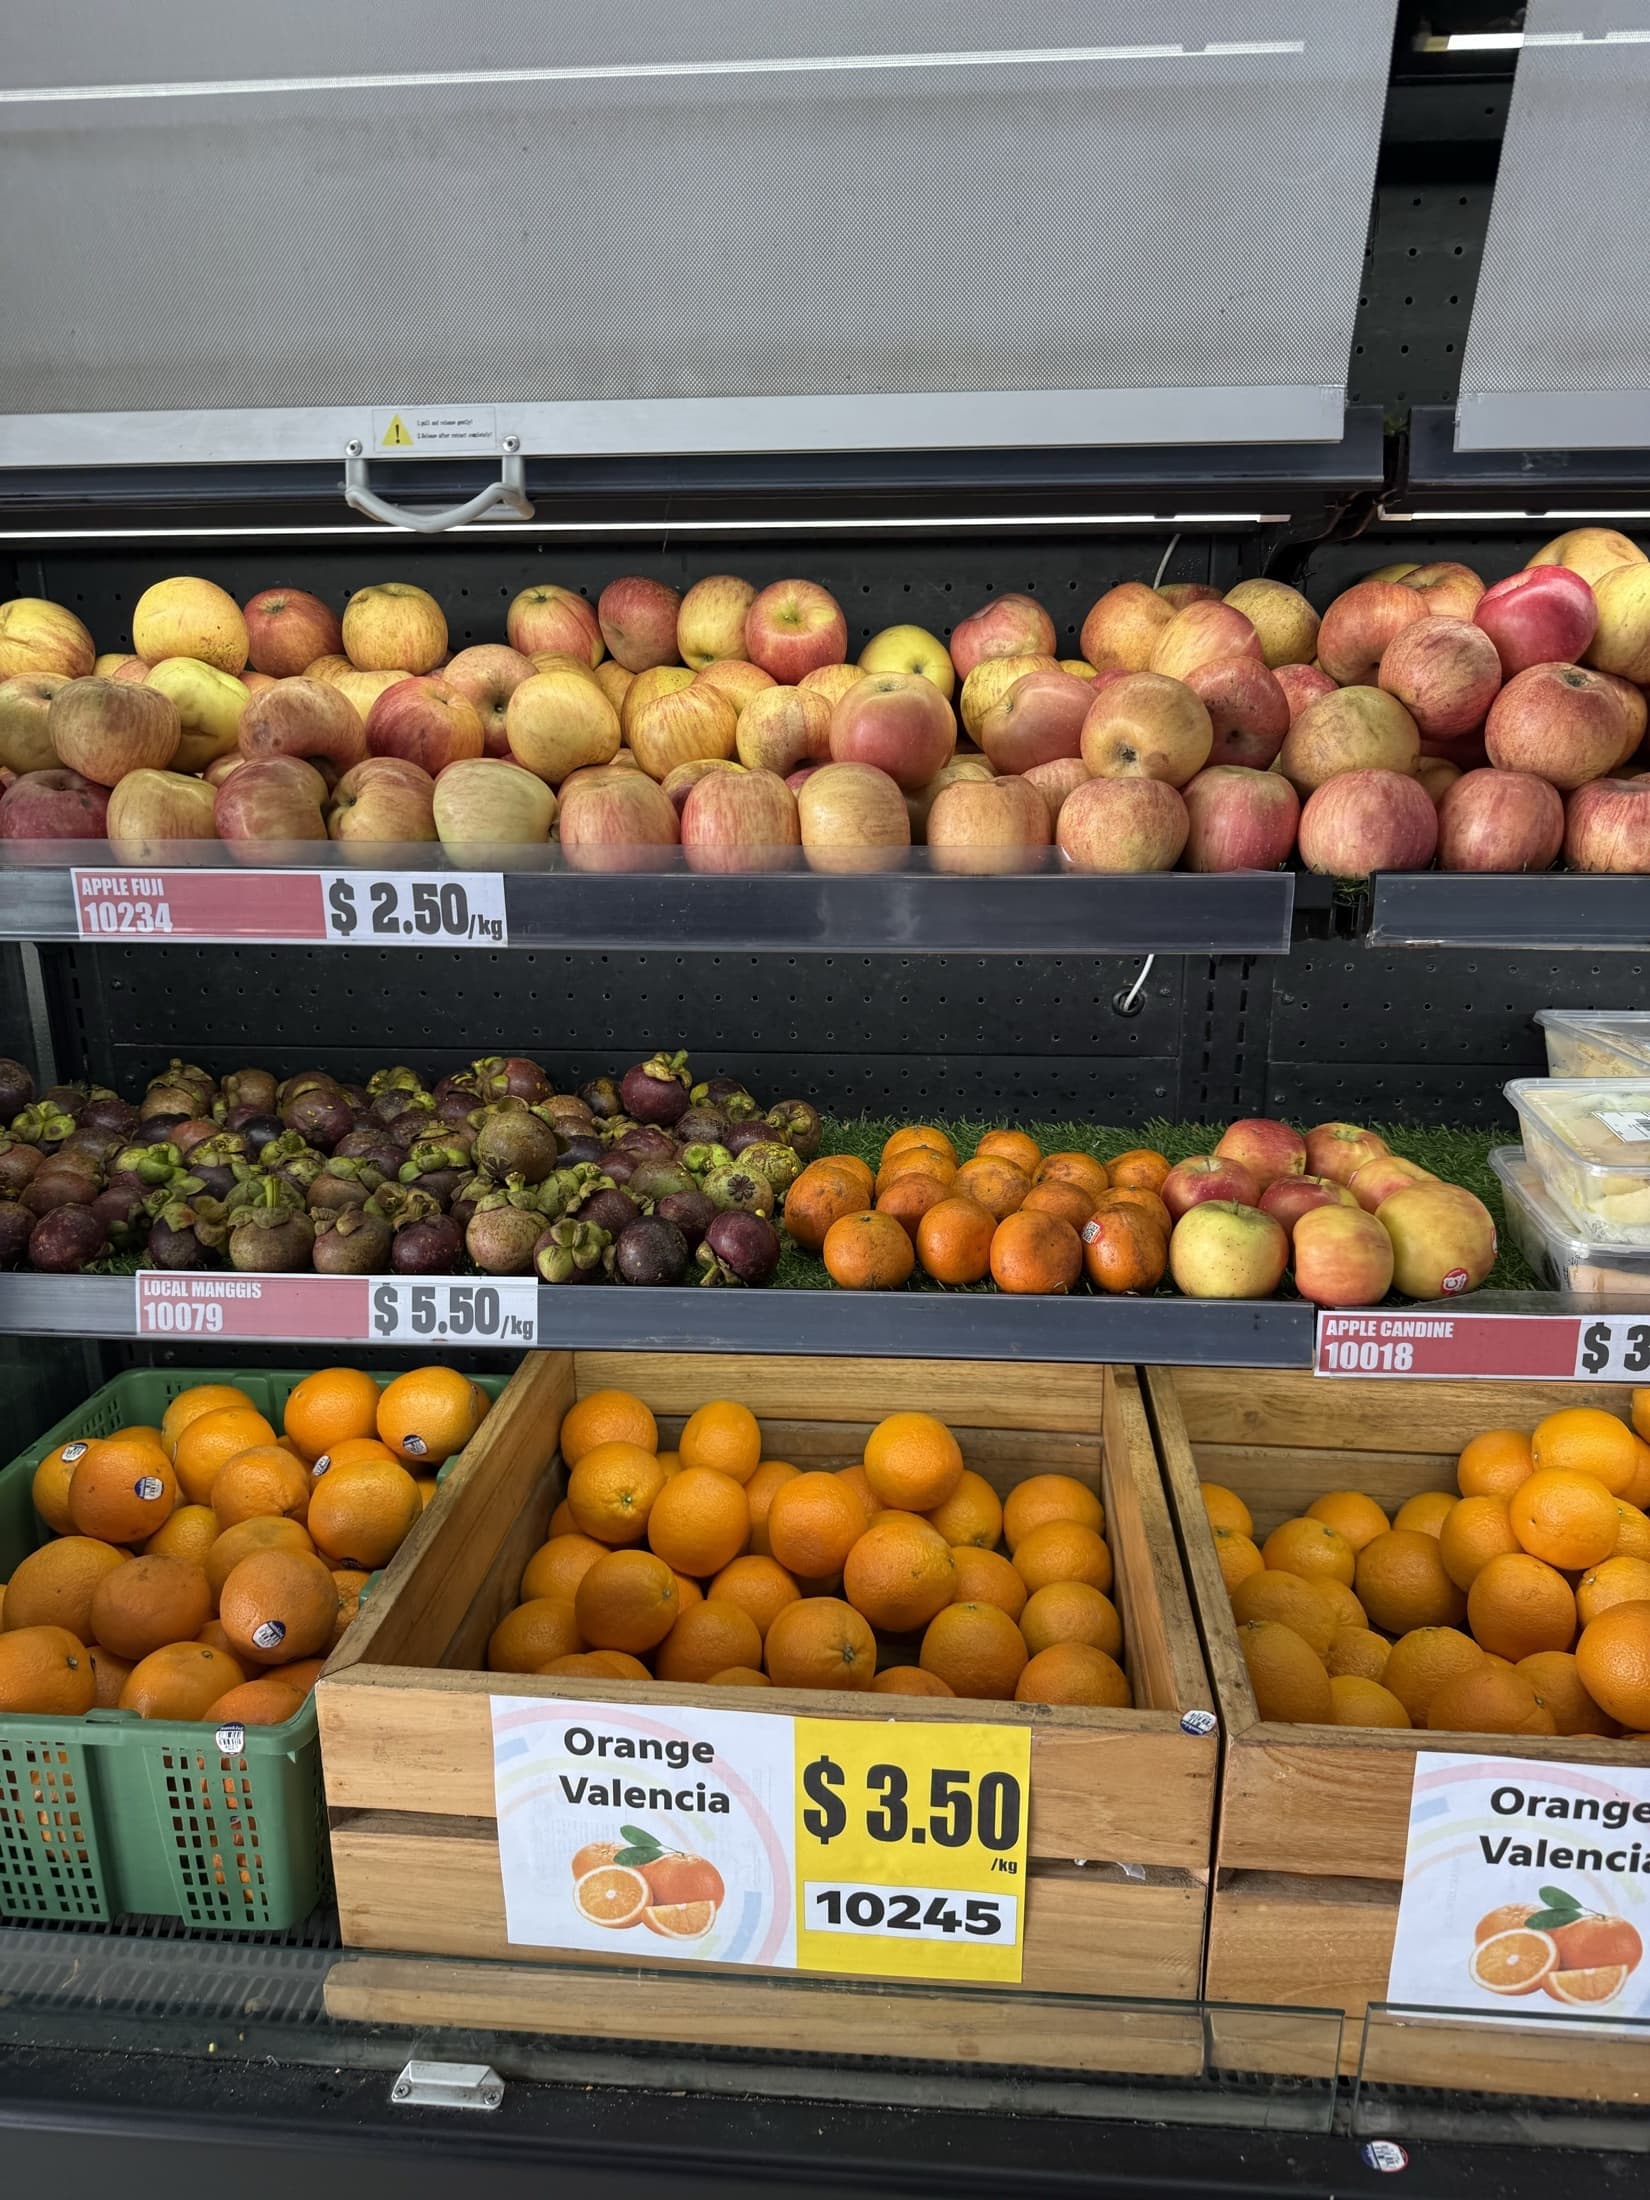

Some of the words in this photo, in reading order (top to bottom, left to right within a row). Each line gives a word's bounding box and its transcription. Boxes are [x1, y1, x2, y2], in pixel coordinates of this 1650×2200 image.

[81, 877, 129, 896] APPLE
[131, 878, 165, 896] FUJI
[84, 902, 173, 932] 10234
[329, 878, 357, 936] $
[370, 882, 503, 940] 2.50/kg
[143, 1279, 188, 1297] LOCAL
[192, 1281, 262, 1299] MANGGIS
[144, 1301, 224, 1332] 10079
[374, 1282, 398, 1336] $
[411, 1286, 534, 1340] 5.50/kg
[1326, 1319, 1376, 1337] APPLE
[1380, 1320, 1454, 1338] CANDINE
[1325, 1341, 1413, 1371] 10018
[1582, 1322, 1611, 1374] $
[564, 1727, 715, 1769] Orange
[559, 1775, 730, 1814] Valencia
[803, 1755, 847, 1845] $
[866, 1763, 1021, 1851] 3.50
[1490, 1786, 1650, 1829] Orange
[991, 1858, 1018, 1874] /kg
[816, 1890, 1002, 1935] 10245
